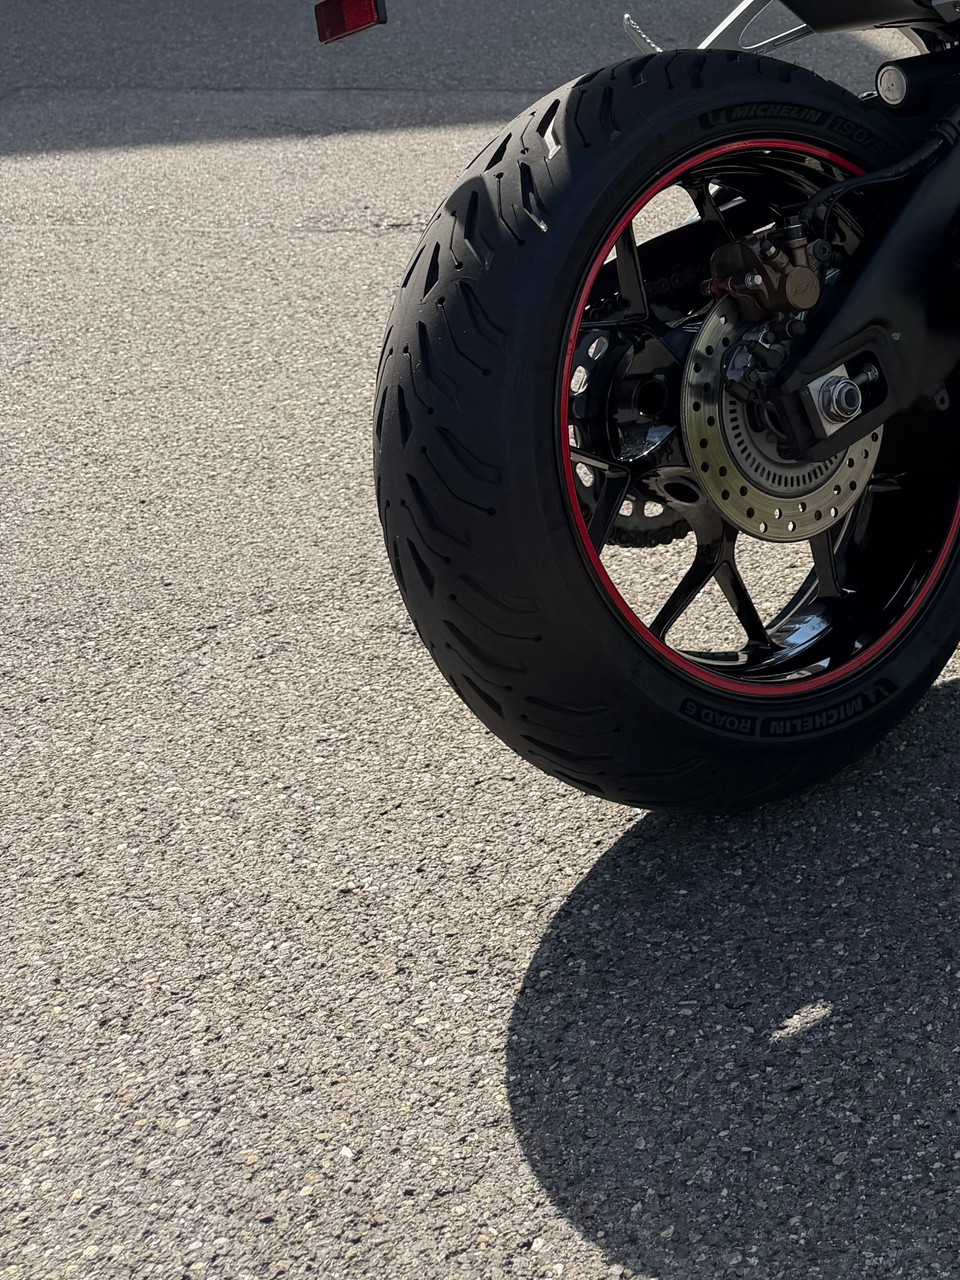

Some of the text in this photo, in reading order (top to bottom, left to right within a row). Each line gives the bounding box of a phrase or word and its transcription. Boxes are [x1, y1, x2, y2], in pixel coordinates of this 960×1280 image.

[732, 103, 822, 122] MICHELIN
[684, 695, 863, 734] MICHELIN ROAD 6
